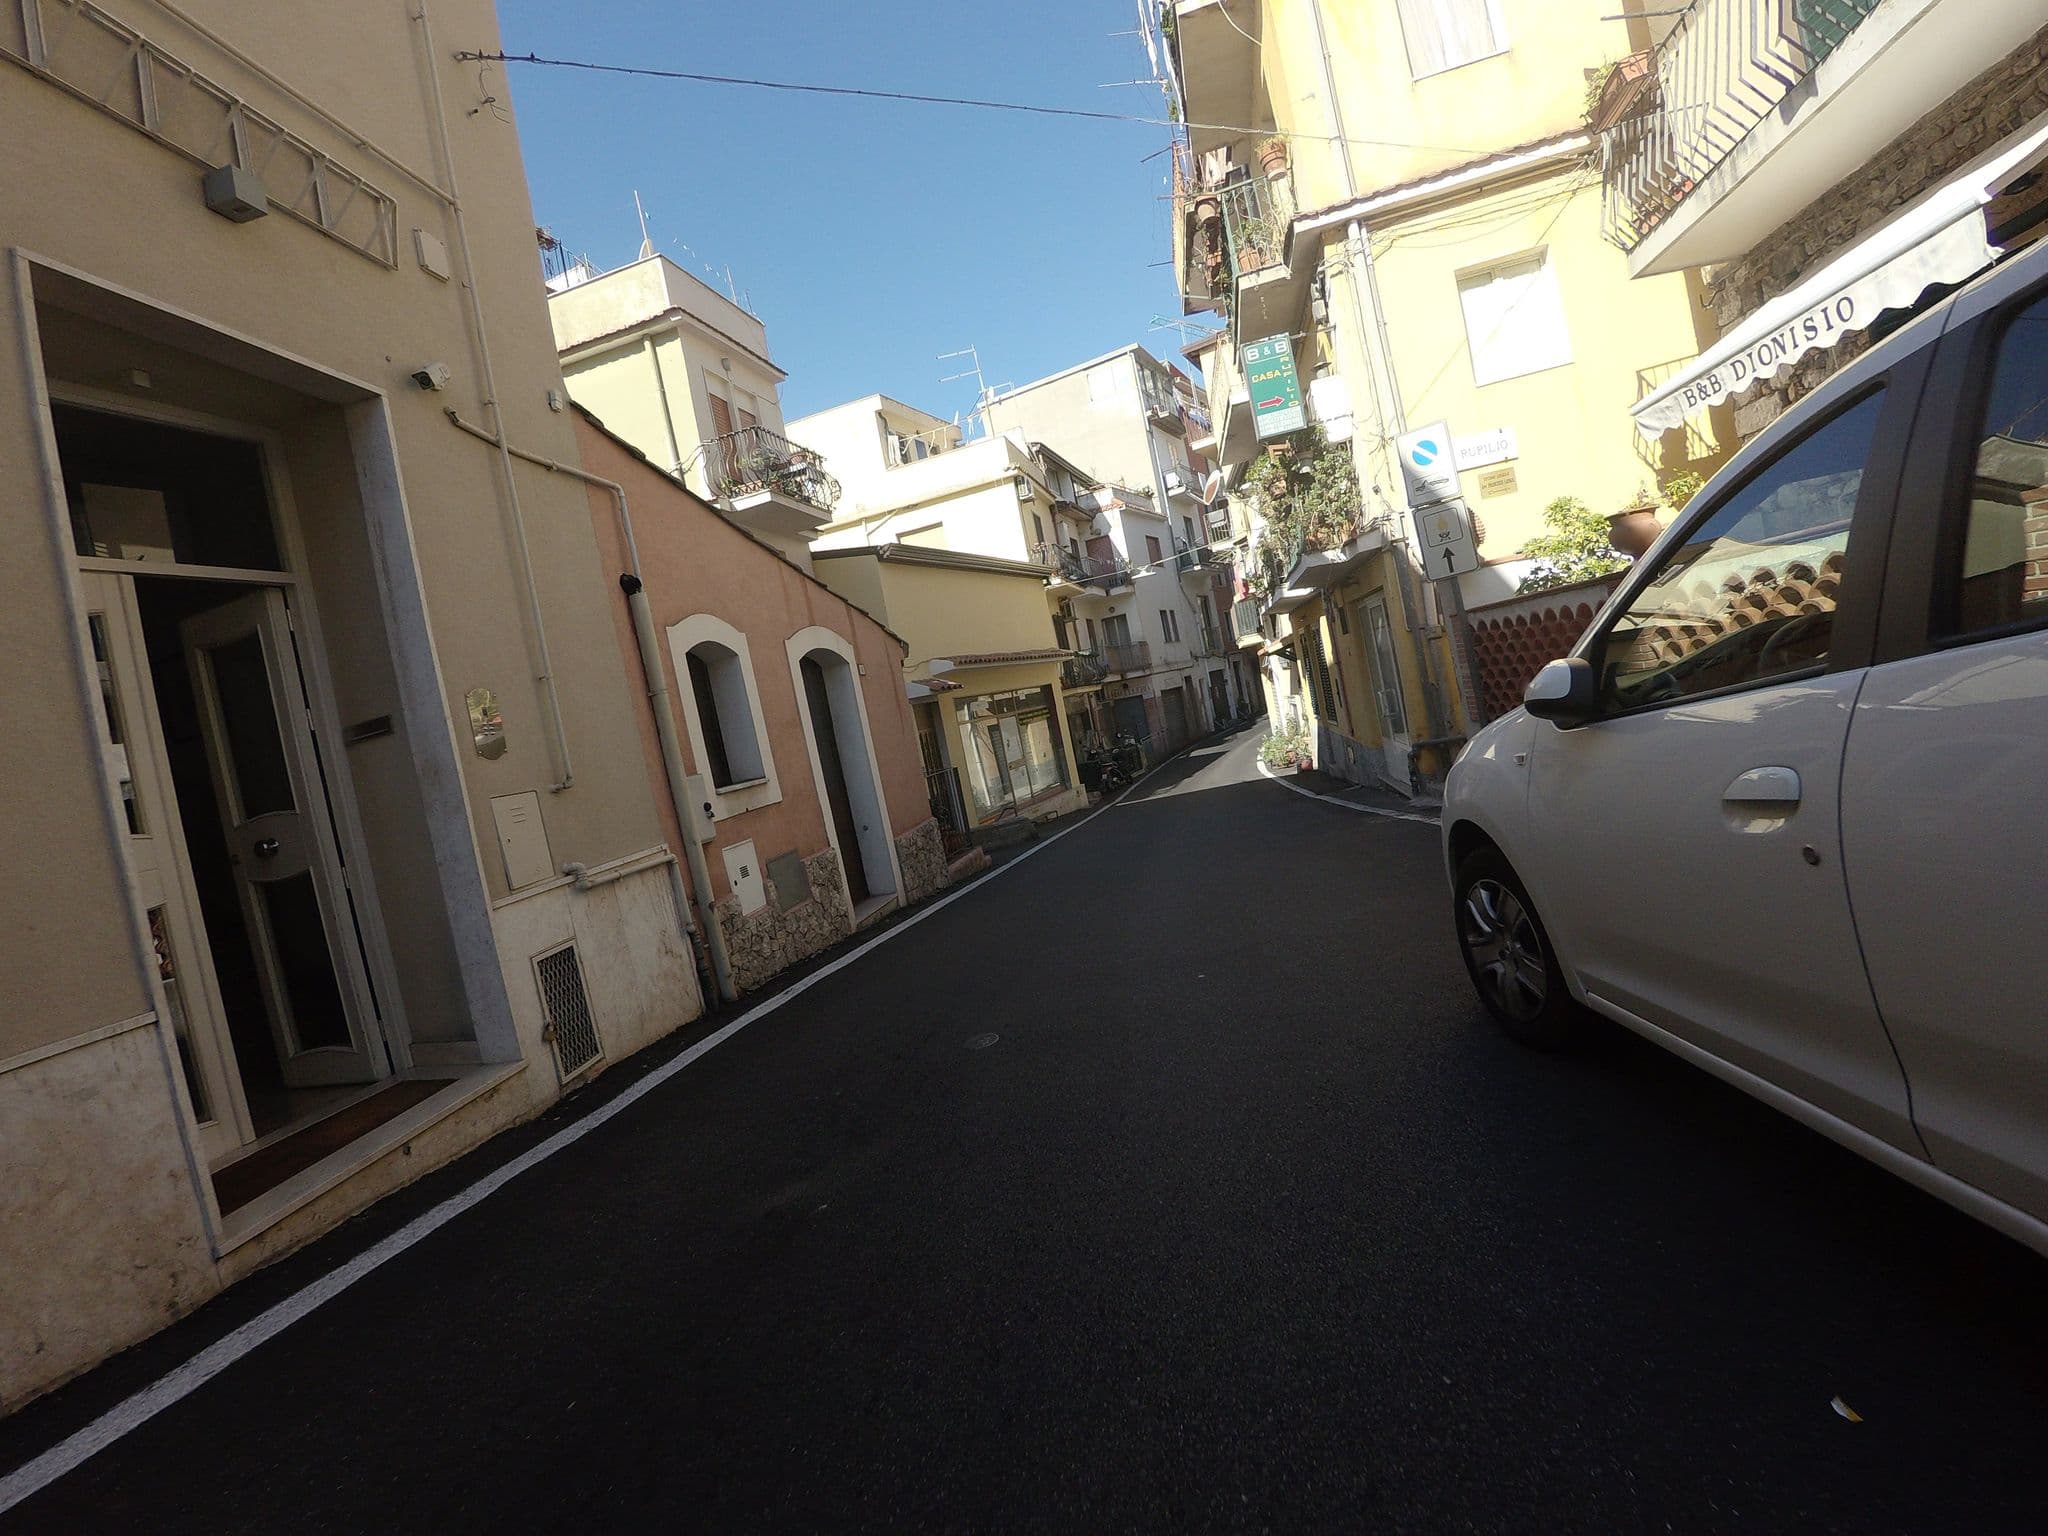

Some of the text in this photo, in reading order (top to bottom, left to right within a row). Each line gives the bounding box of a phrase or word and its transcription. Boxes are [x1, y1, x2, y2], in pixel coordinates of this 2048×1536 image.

[1246, 341, 1287, 361] B & B
[1683, 296, 1854, 408] B&B DIONISIO
[1251, 369, 1281, 383] CASA
[1280, 354, 1299, 408] RUPILIO
[1460, 439, 1509, 459] RUPILIO
